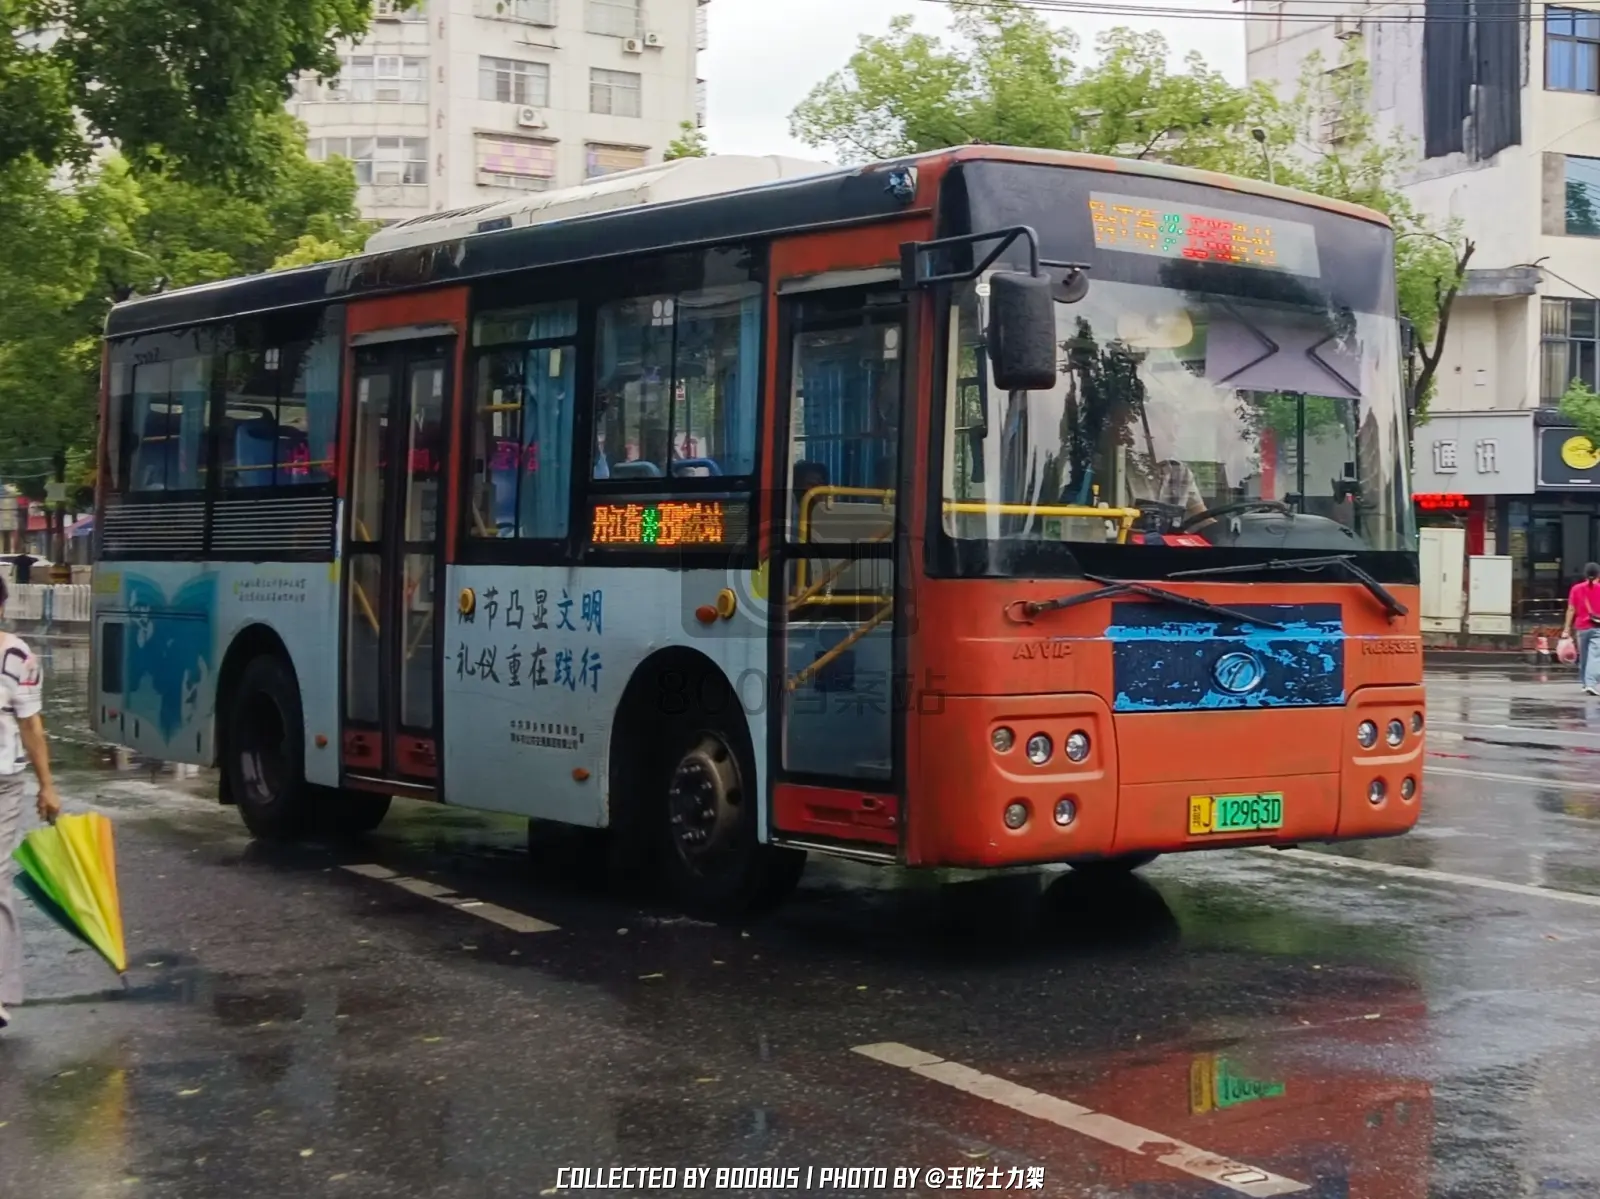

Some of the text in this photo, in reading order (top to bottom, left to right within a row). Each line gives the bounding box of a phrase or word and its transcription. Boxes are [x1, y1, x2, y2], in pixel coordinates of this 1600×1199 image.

[1410, 439, 1500, 474] 通讯
[456, 641, 603, 693] 礼仪重在践行
